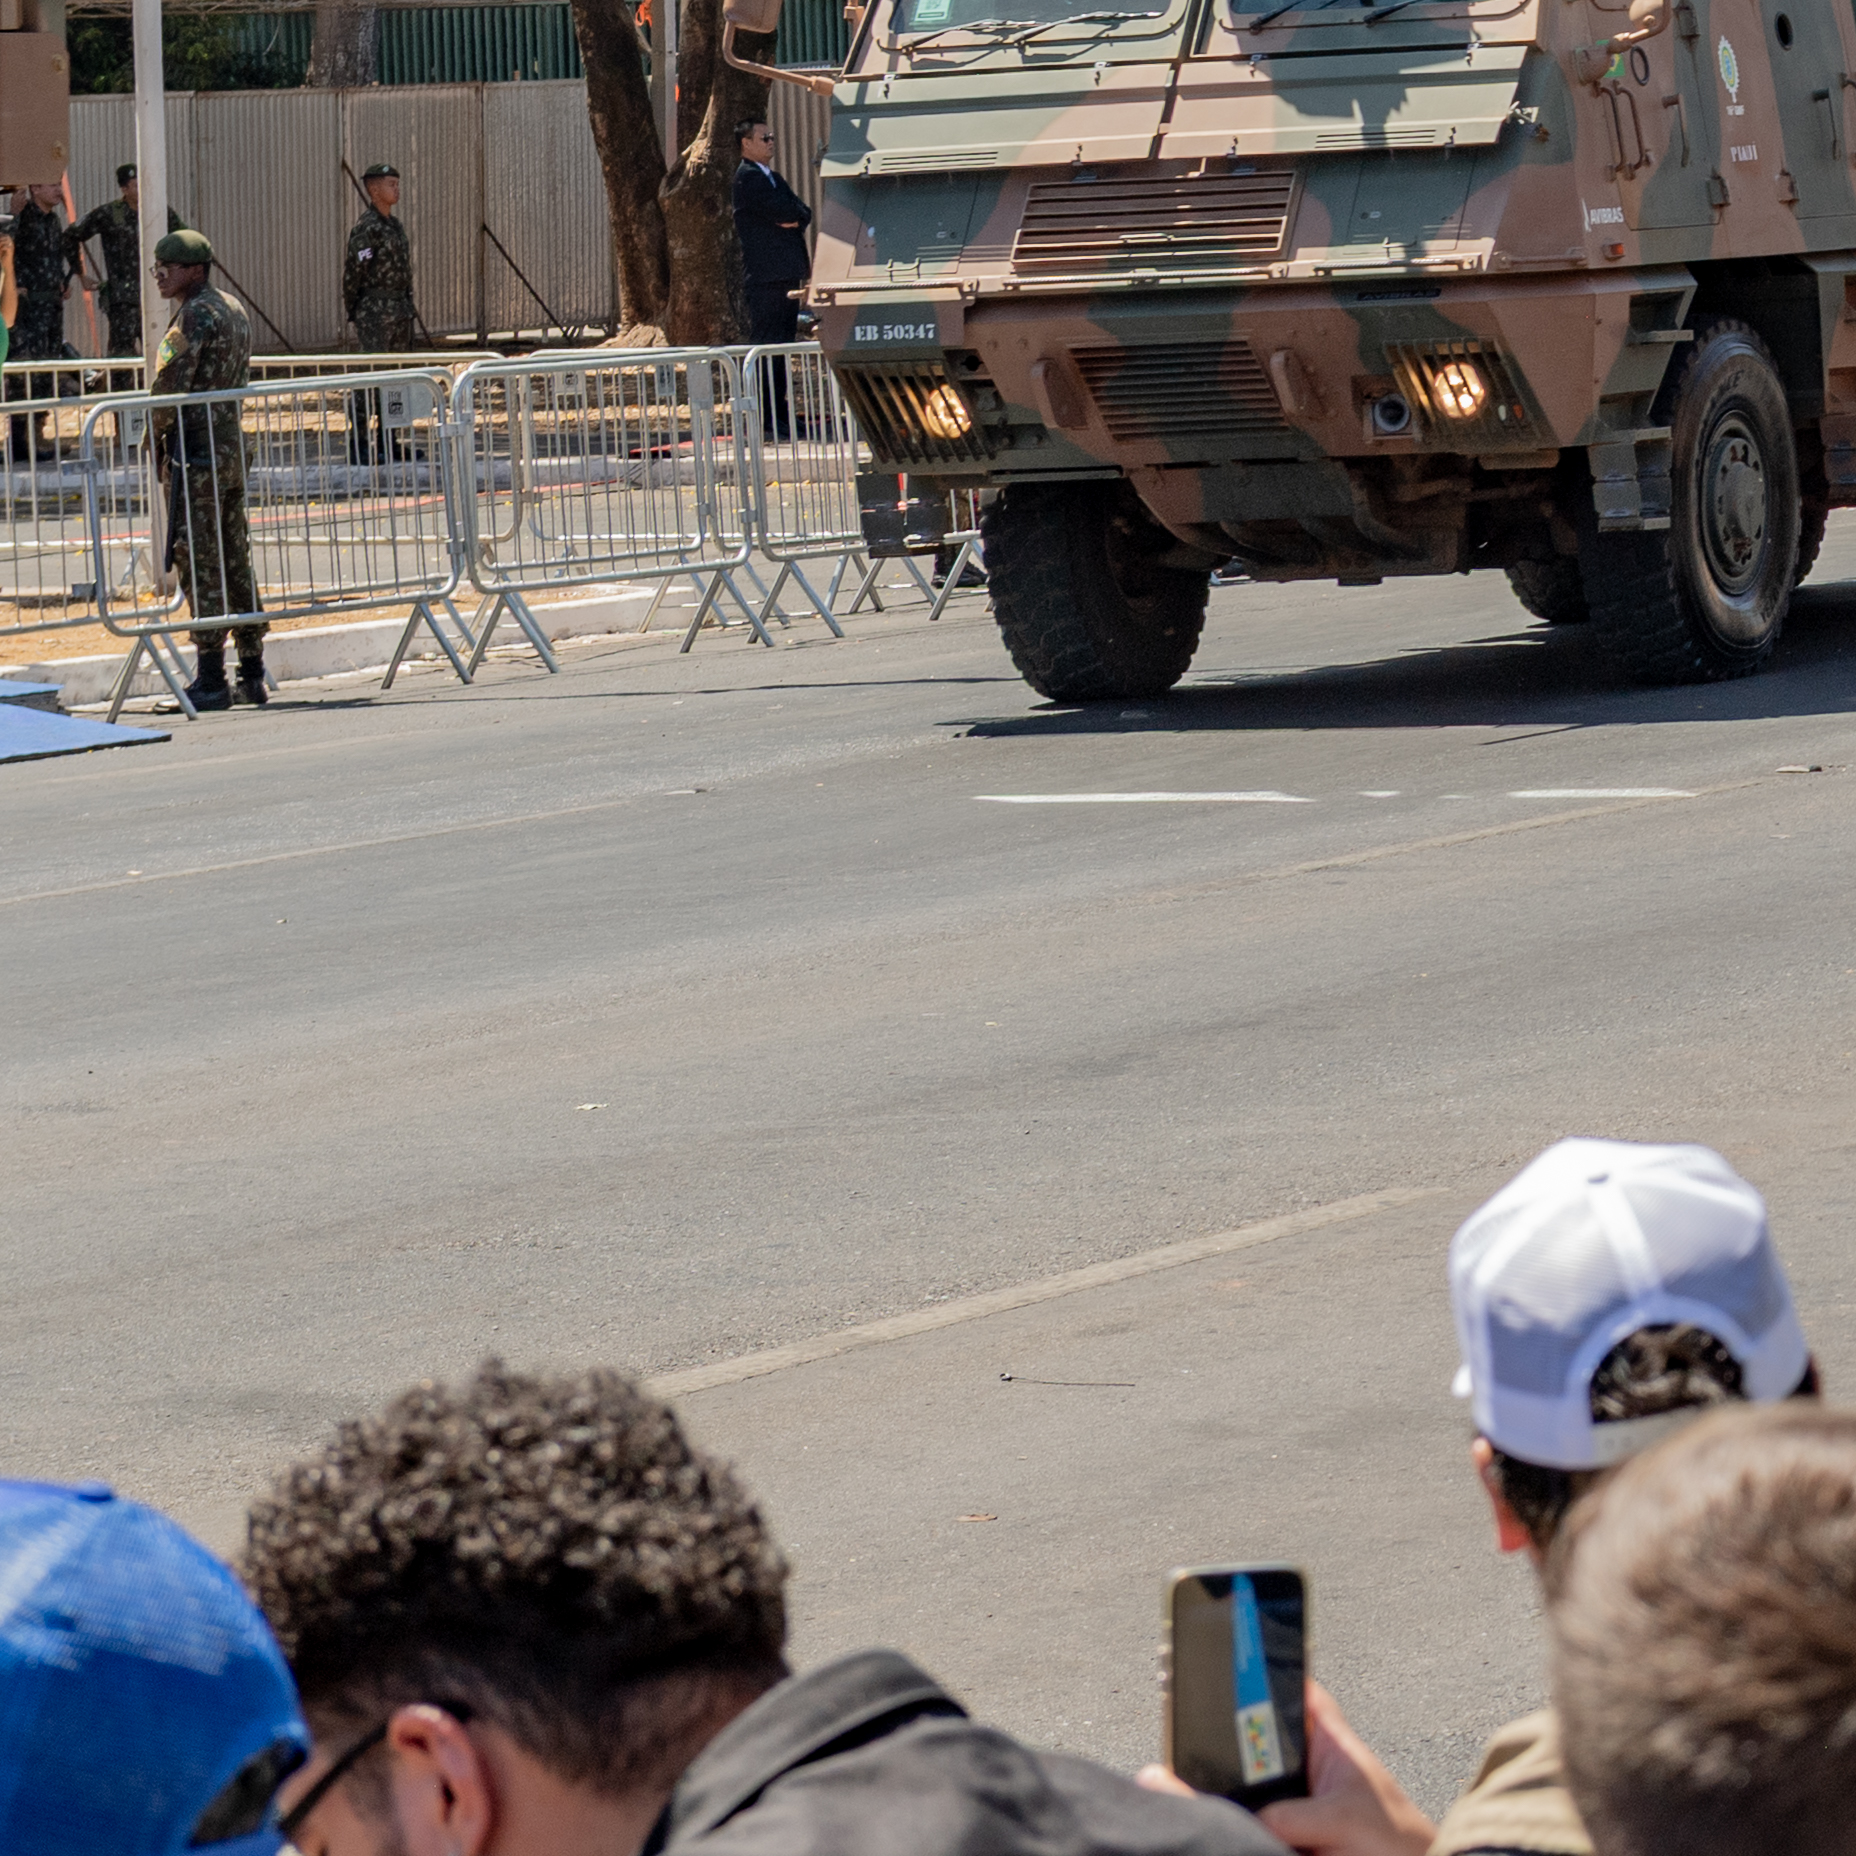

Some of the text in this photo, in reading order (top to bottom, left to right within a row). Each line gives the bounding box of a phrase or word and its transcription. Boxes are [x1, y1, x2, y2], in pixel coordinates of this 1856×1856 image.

[1590, 207, 1624, 225] AVIBRAS
[357, 247, 374, 262] PE
[854, 323, 936, 341] EB 50347
